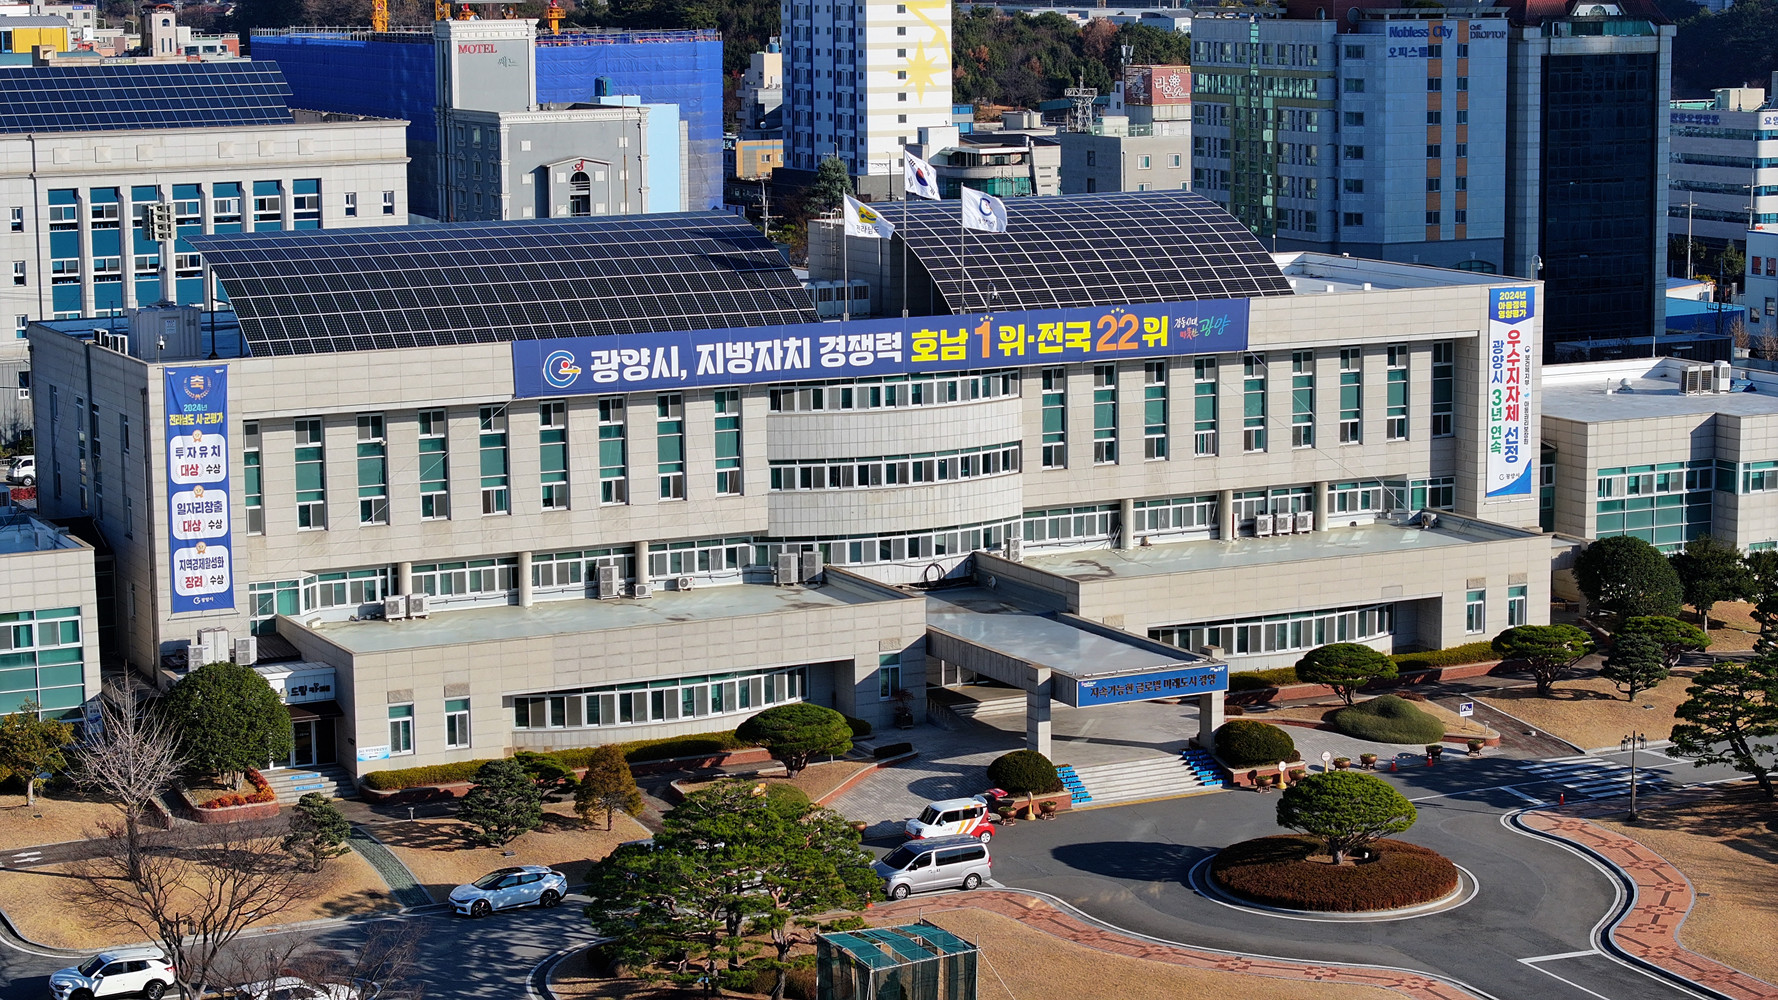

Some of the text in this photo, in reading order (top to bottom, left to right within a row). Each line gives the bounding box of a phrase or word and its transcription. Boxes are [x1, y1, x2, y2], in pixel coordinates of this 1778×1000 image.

[1389, 25, 1453, 39] Nobless City
[1470, 30, 1506, 39] DROPTOP
[458, 44, 497, 54] MOTEL
[1388, 47, 1428, 58] 오피스텔
[1499, 291, 1527, 301] 2024년
[1199, 314, 1231, 336] 광양
[590, 345, 688, 383] 광양시,
[696, 337, 811, 376] 지방자치
[819, 331, 902, 368] 경쟁력
[911, 328, 969, 362] 호남
[190, 375, 204, 389] 축
[1490, 340, 1504, 454] 광양시 3년 연속
[1505, 329, 1521, 463] 우수지자체 선정
[183, 403, 207, 412] 2024년
[169, 413, 194, 425] 전라남도
[180, 464, 221, 476] 대상 수상
[177, 501, 222, 515] 일자리창출
[183, 519, 222, 532] 대상 수상
[179, 556, 224, 571] 지역경제활성화
[185, 575, 224, 588] 장려 수상
[291, 685, 307, 696] 드림
[1090, 684, 1134, 698] 지속가능한
[1136, 678, 1162, 693] 글로벌
[1163, 676, 1197, 690] 미래도시
[1199, 674, 1216, 687] 광양
